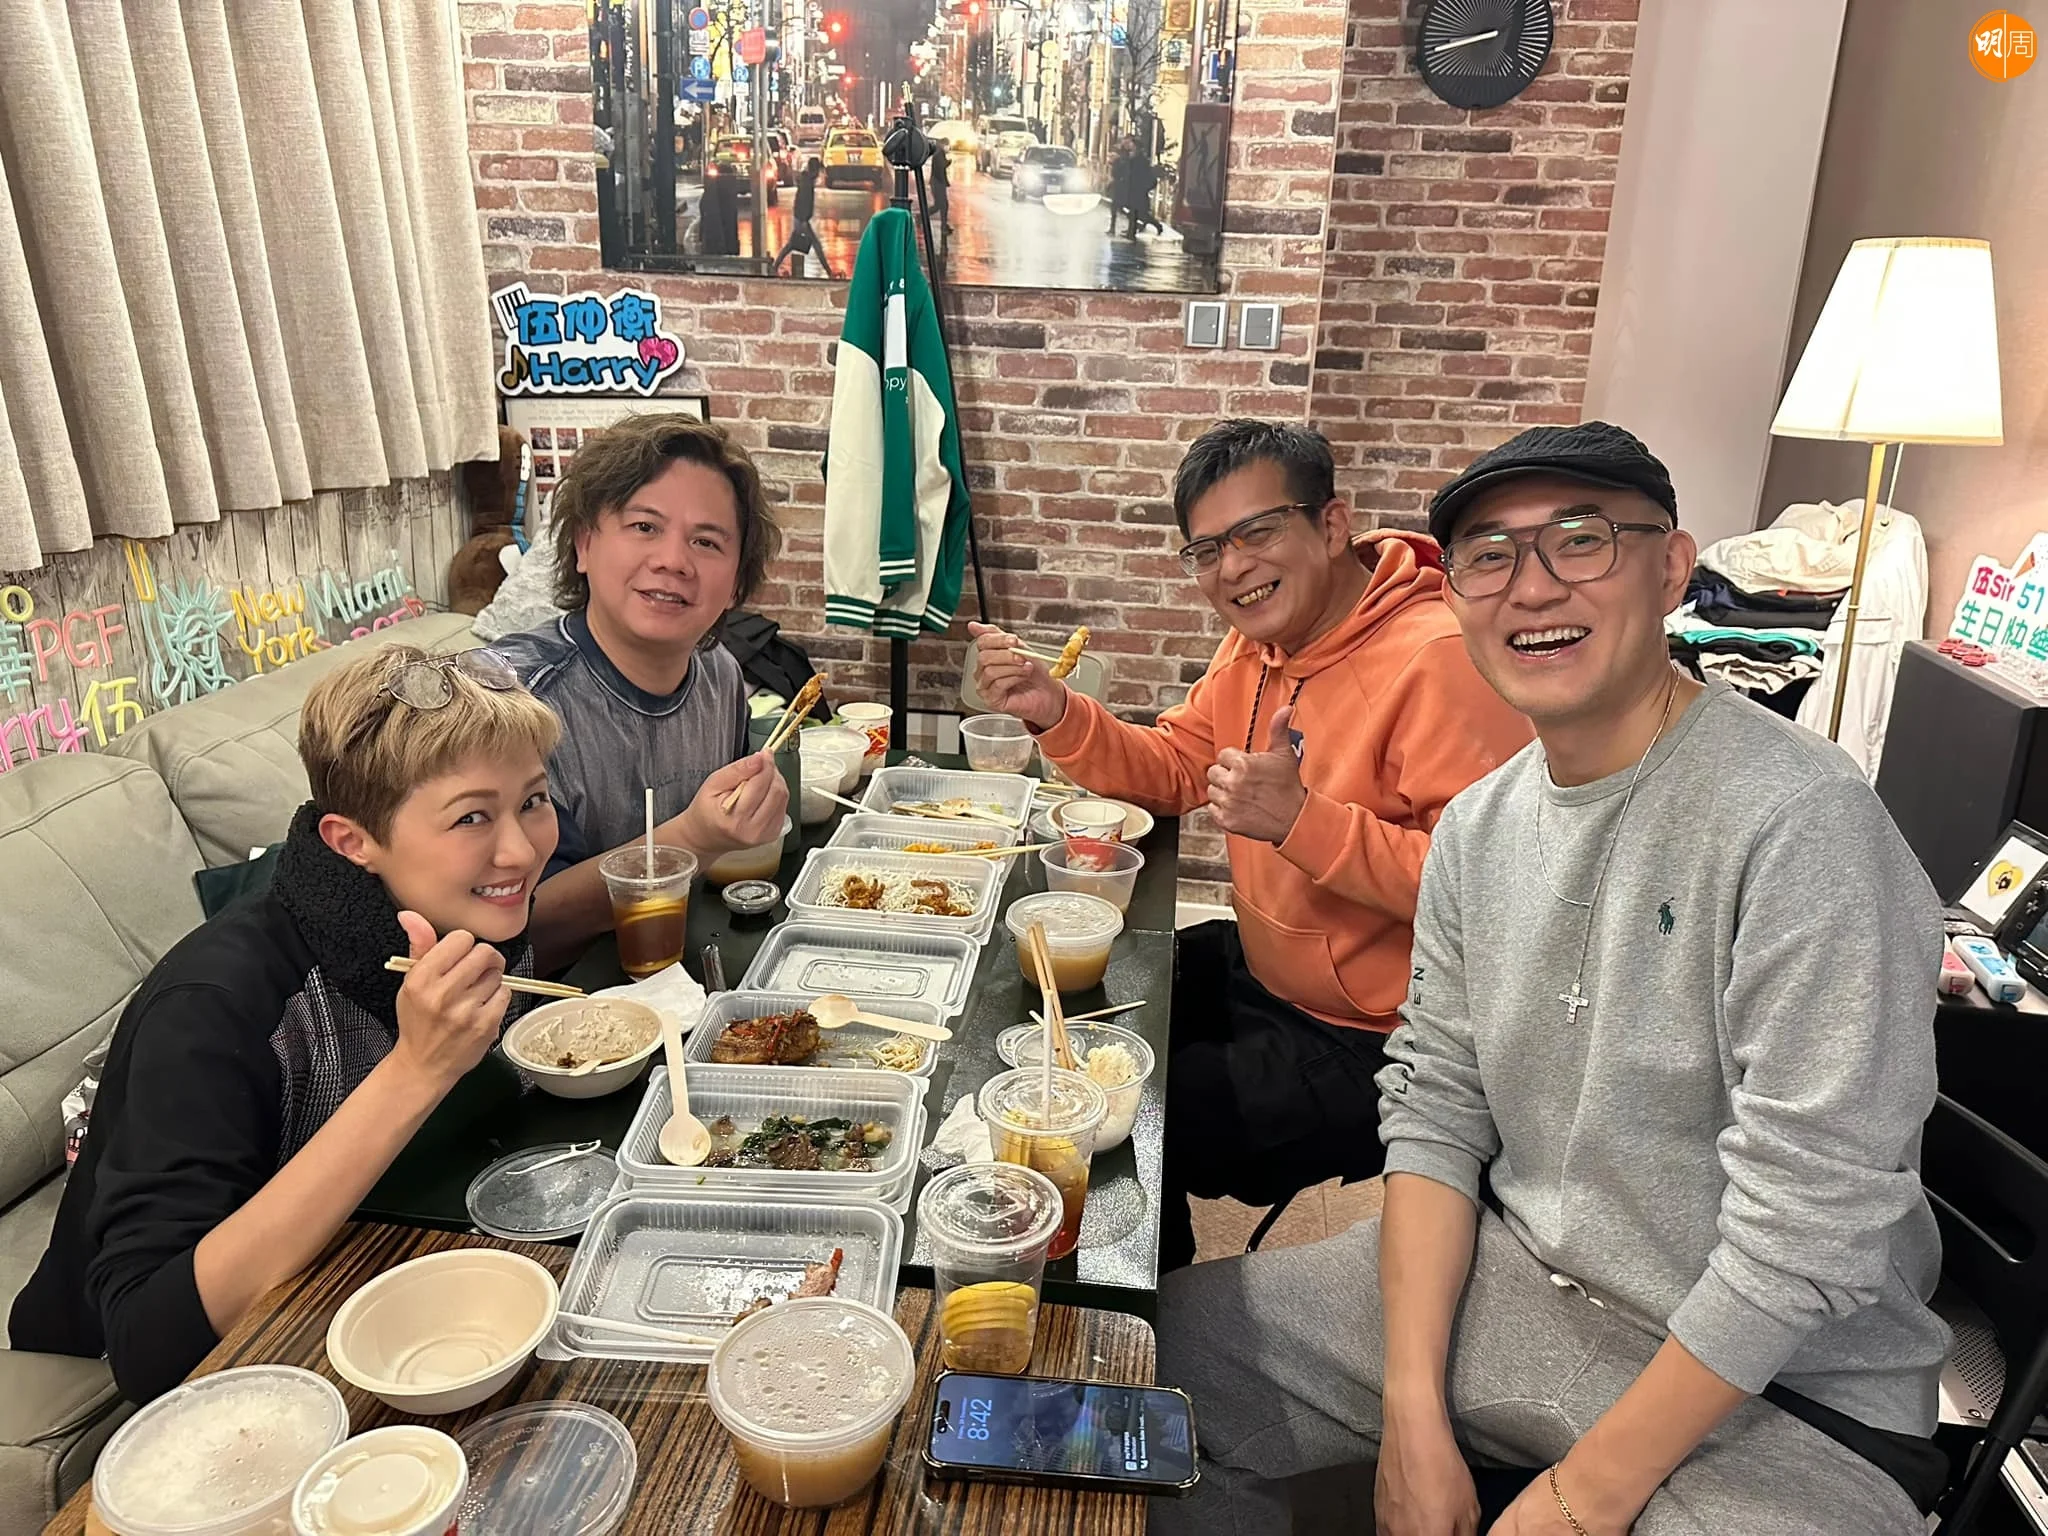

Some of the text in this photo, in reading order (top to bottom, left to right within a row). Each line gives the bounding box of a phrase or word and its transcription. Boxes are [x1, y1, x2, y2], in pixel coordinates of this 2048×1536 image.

[515, 292, 658, 345] 伍仲衡
[528, 351, 661, 389] Harry
[229, 580, 305, 634] New
[302, 548, 414, 637] Miami
[2016, 581, 2046, 615] 51
[26, 603, 125, 683] PGF
[237, 615, 321, 674] York
[0, 698, 89, 772] rry
[967, 1398, 992, 1440] 8:42
